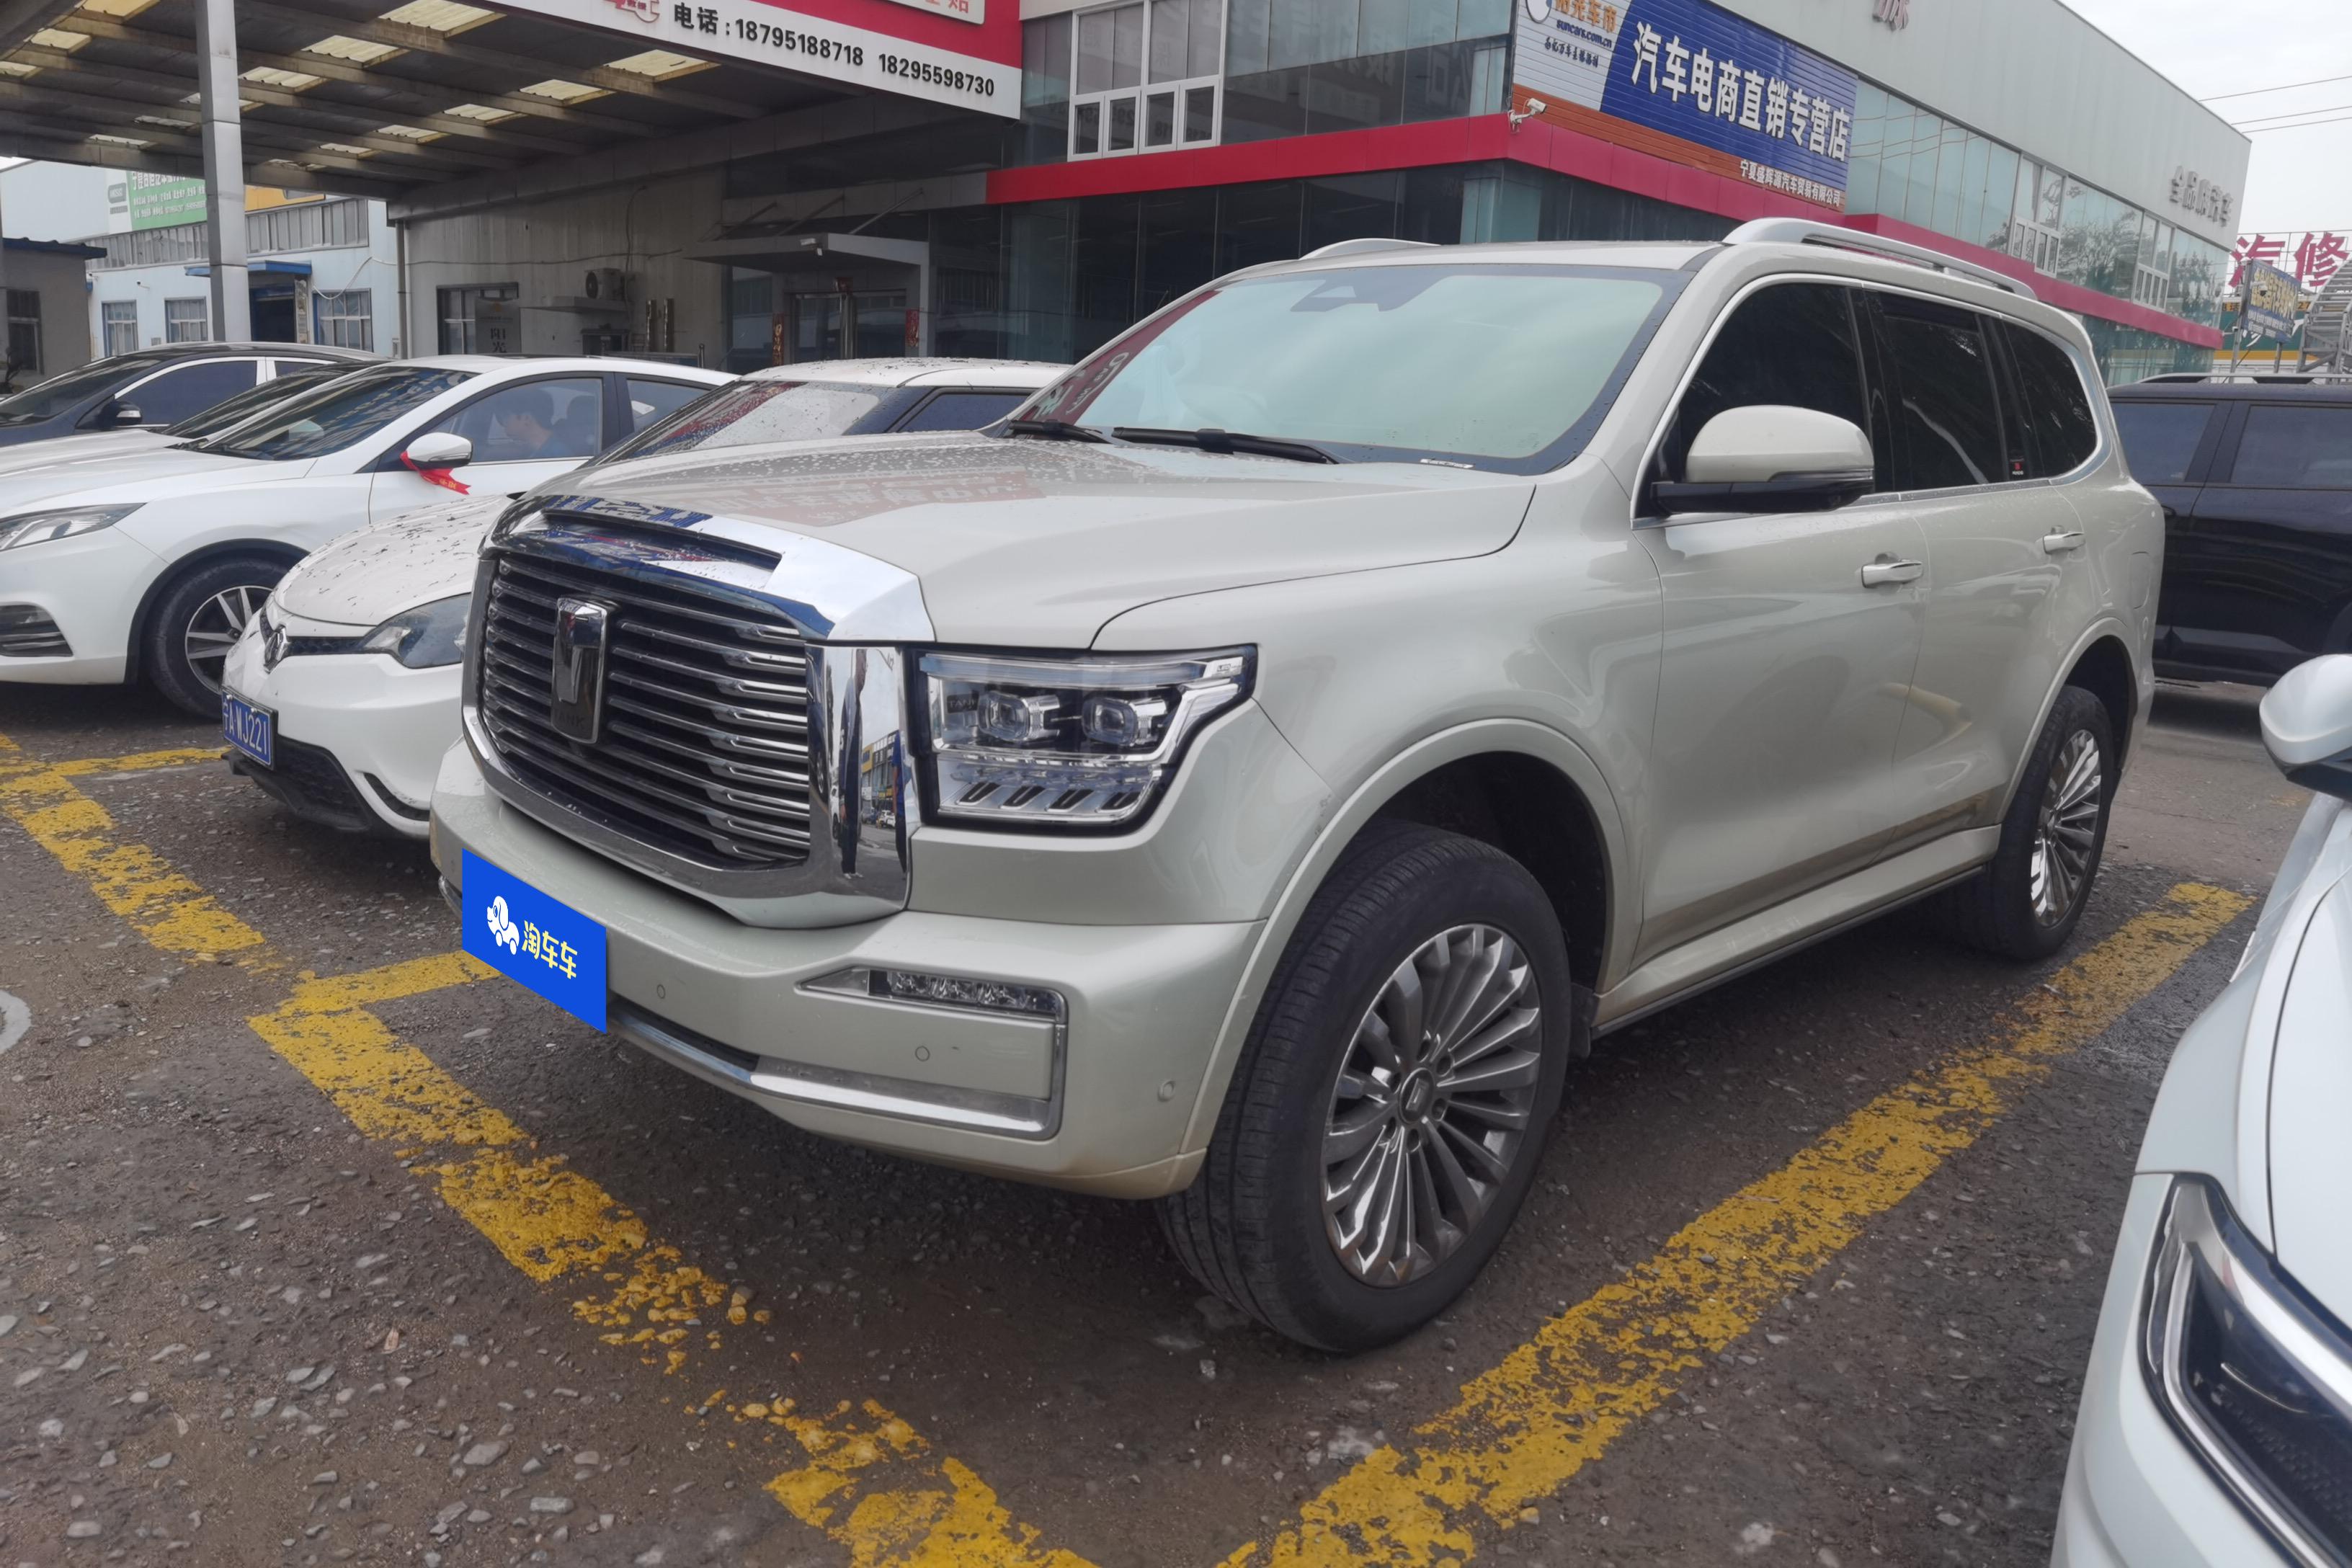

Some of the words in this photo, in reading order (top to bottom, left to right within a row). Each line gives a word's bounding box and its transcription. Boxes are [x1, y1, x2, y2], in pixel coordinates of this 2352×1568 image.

[1556, 19, 1613, 49] suncars.com.cn
[878, 53, 995, 97] 18295598730
[1631, 21, 1850, 163] 汽车电商直销专营店
